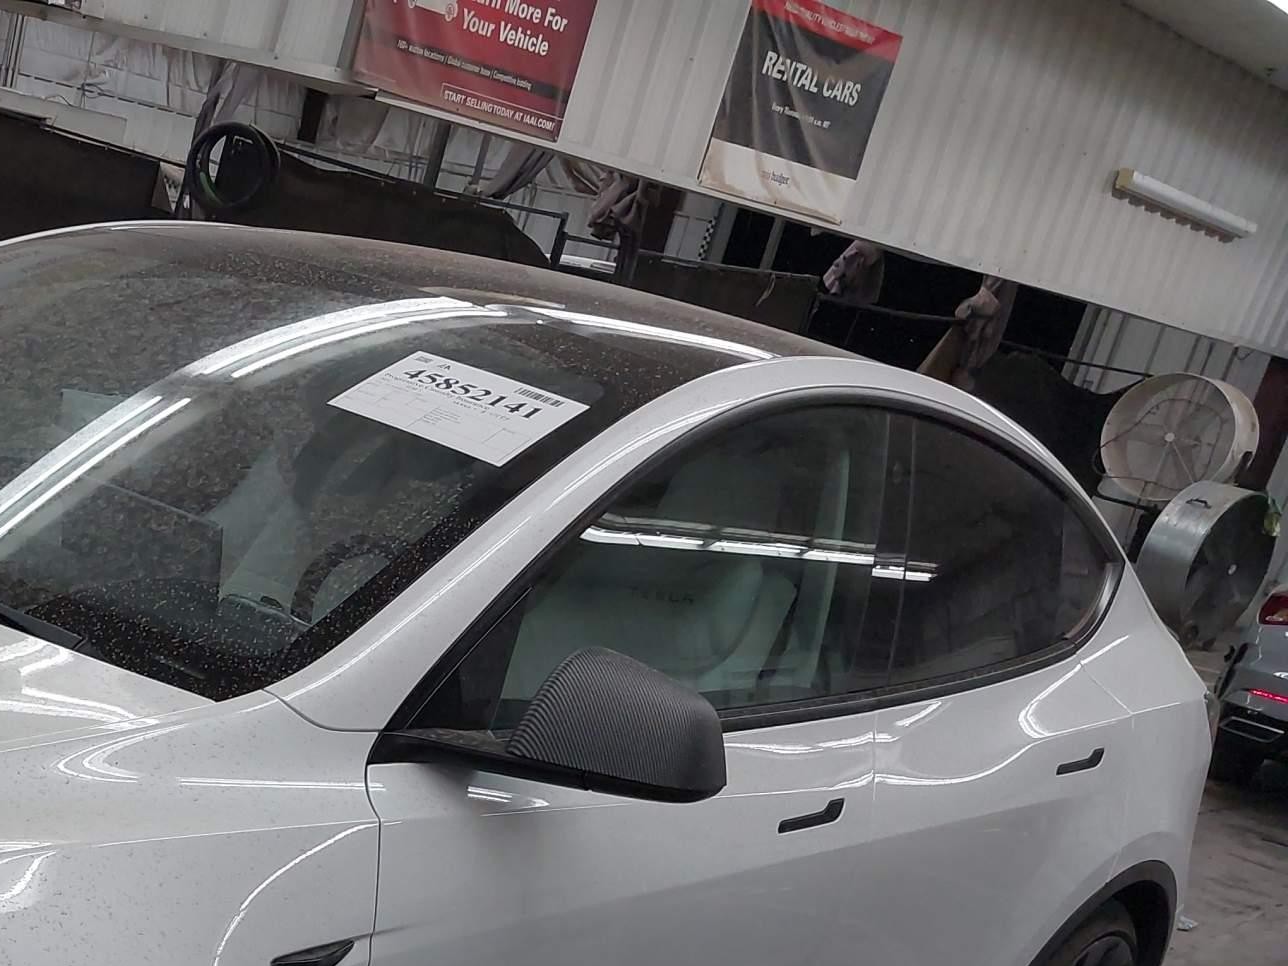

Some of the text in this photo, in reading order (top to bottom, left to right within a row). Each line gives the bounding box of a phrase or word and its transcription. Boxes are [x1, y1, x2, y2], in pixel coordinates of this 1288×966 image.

[463, 8, 549, 56] Your Vehicle
[505, 0, 568, 32] More For
[762, 50, 862, 106] RENTAL CARS
[444, 90, 466, 105] START
[466, 96, 493, 113] SELLING
[493, 103, 514, 119] TODAY
[514, 111, 524, 121] AT
[403, 368, 543, 419] 45852141
